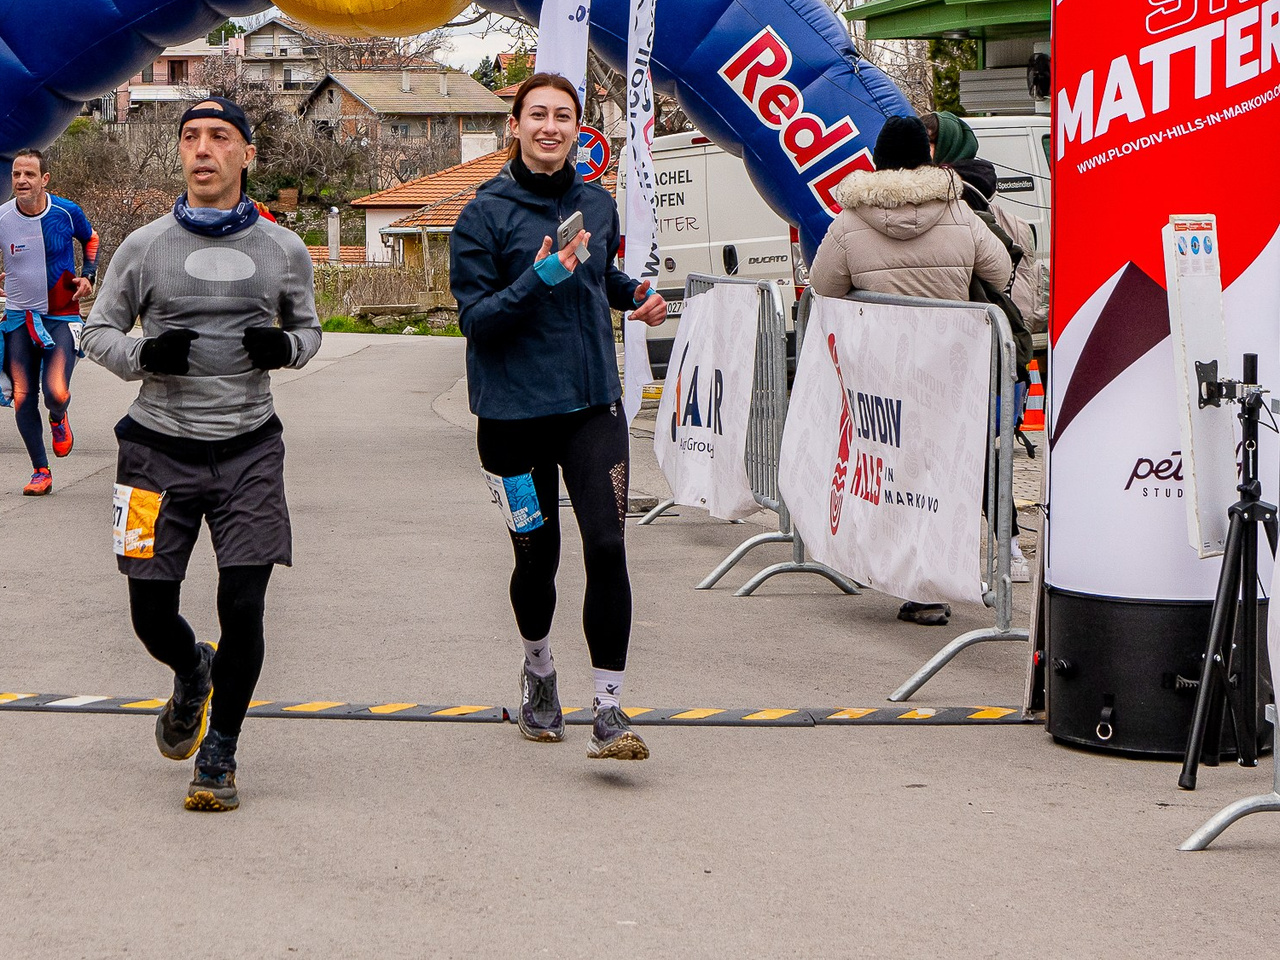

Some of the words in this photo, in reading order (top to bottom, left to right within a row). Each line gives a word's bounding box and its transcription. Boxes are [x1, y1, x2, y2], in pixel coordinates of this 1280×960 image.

[721, 28, 857, 171] Red
[1076, 84, 1280, 174] WWW.PLOVDIV-HILLS-IN-MARKOVO.C
[748, 254, 789, 265] DUCATO
[847, 388, 902, 448] OVDIV
[884, 466, 895, 483] IN
[884, 489, 939, 514] MARKOVO
